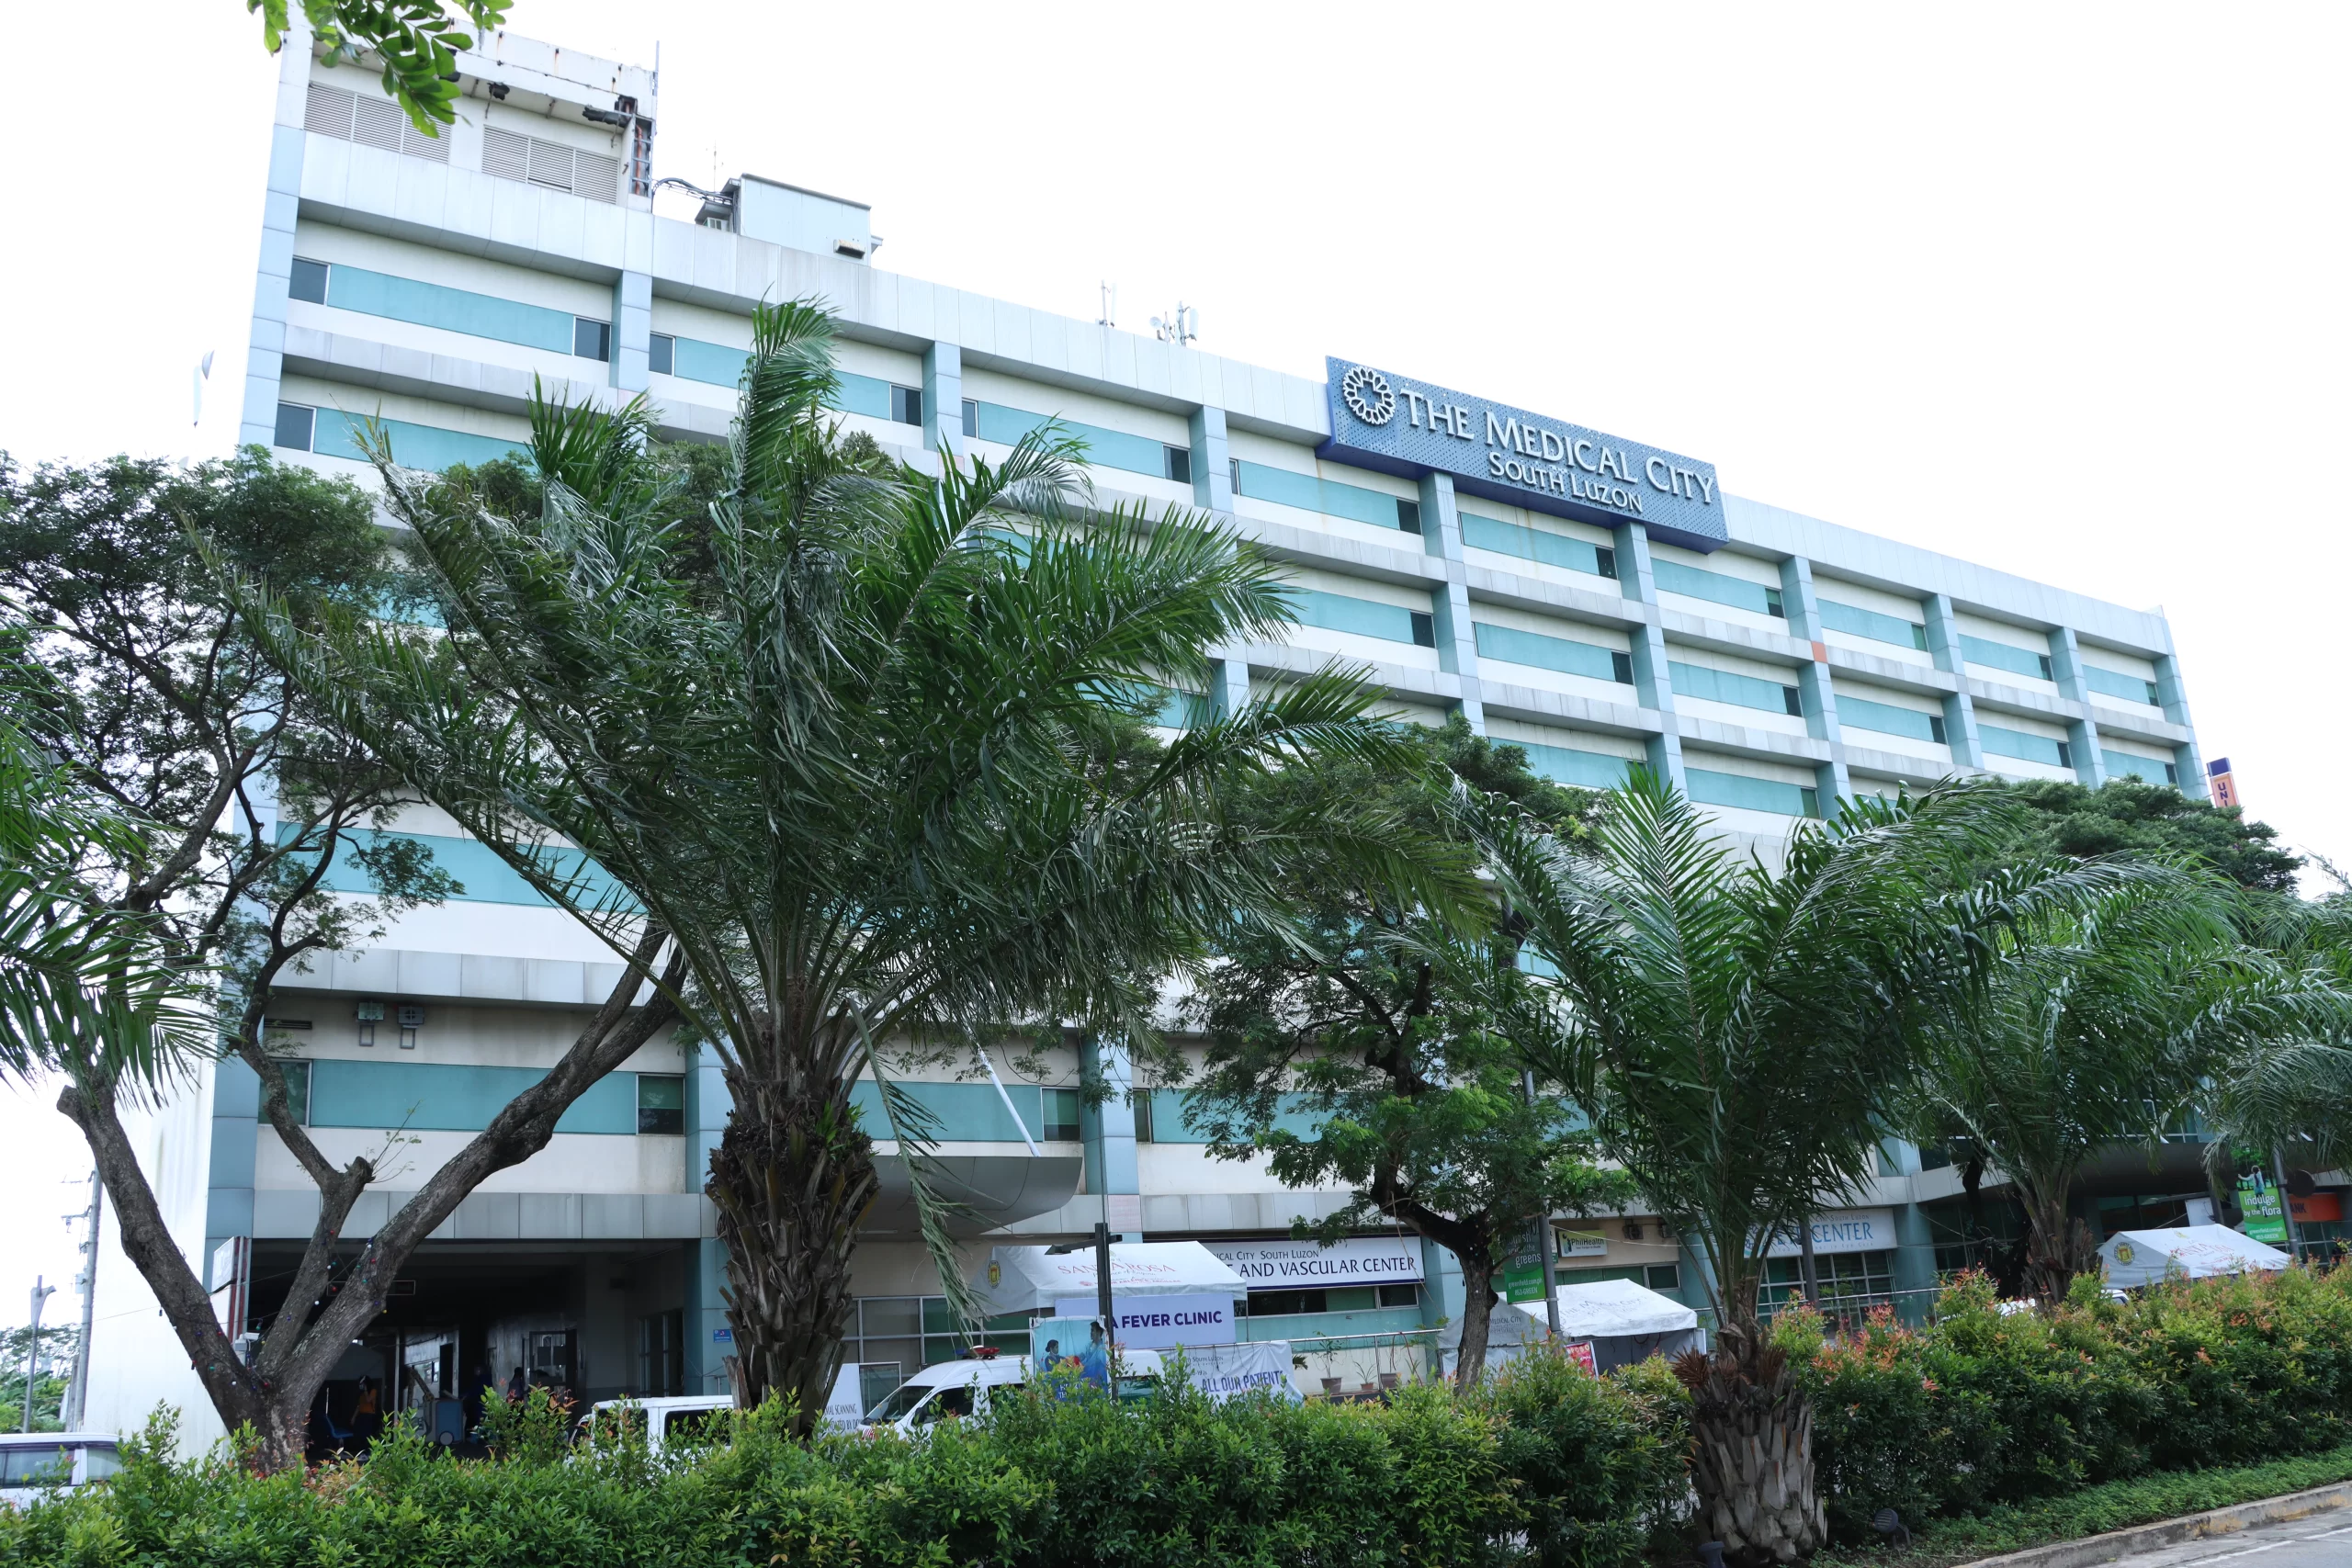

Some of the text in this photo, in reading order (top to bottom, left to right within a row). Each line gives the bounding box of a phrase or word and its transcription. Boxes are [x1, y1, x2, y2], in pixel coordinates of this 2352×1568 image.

[1399, 389, 1713, 504] THE MEDICAL CITY
[1488, 451, 1643, 513] SOUTH LUZON
[2245, 1194, 2276, 1206] Indulge
[2261, 1205, 2282, 1217] flora
[1812, 1222, 1874, 1243] CENTER
[1571, 1237, 1605, 1246] PhilHealth
[1237, 1250, 1255, 1260] CITY
[1261, 1249, 1288, 1260] SOUTH
[1292, 1248, 1320, 1259] LUZON
[1515, 1253, 1542, 1269] greens
[1057, 1262, 1125, 1274] SANA
[1239, 1257, 1416, 1278] AND VASCULAR CENTER
[1121, 1314, 1170, 1328] FEVER
[1174, 1310, 1223, 1325] CLINIC
[1510, 1315, 1521, 1324] CITY
[1202, 1378, 1220, 1393] ALL
[1221, 1376, 1242, 1392] OUR
[834, 1403, 856, 1416] SCANNING
